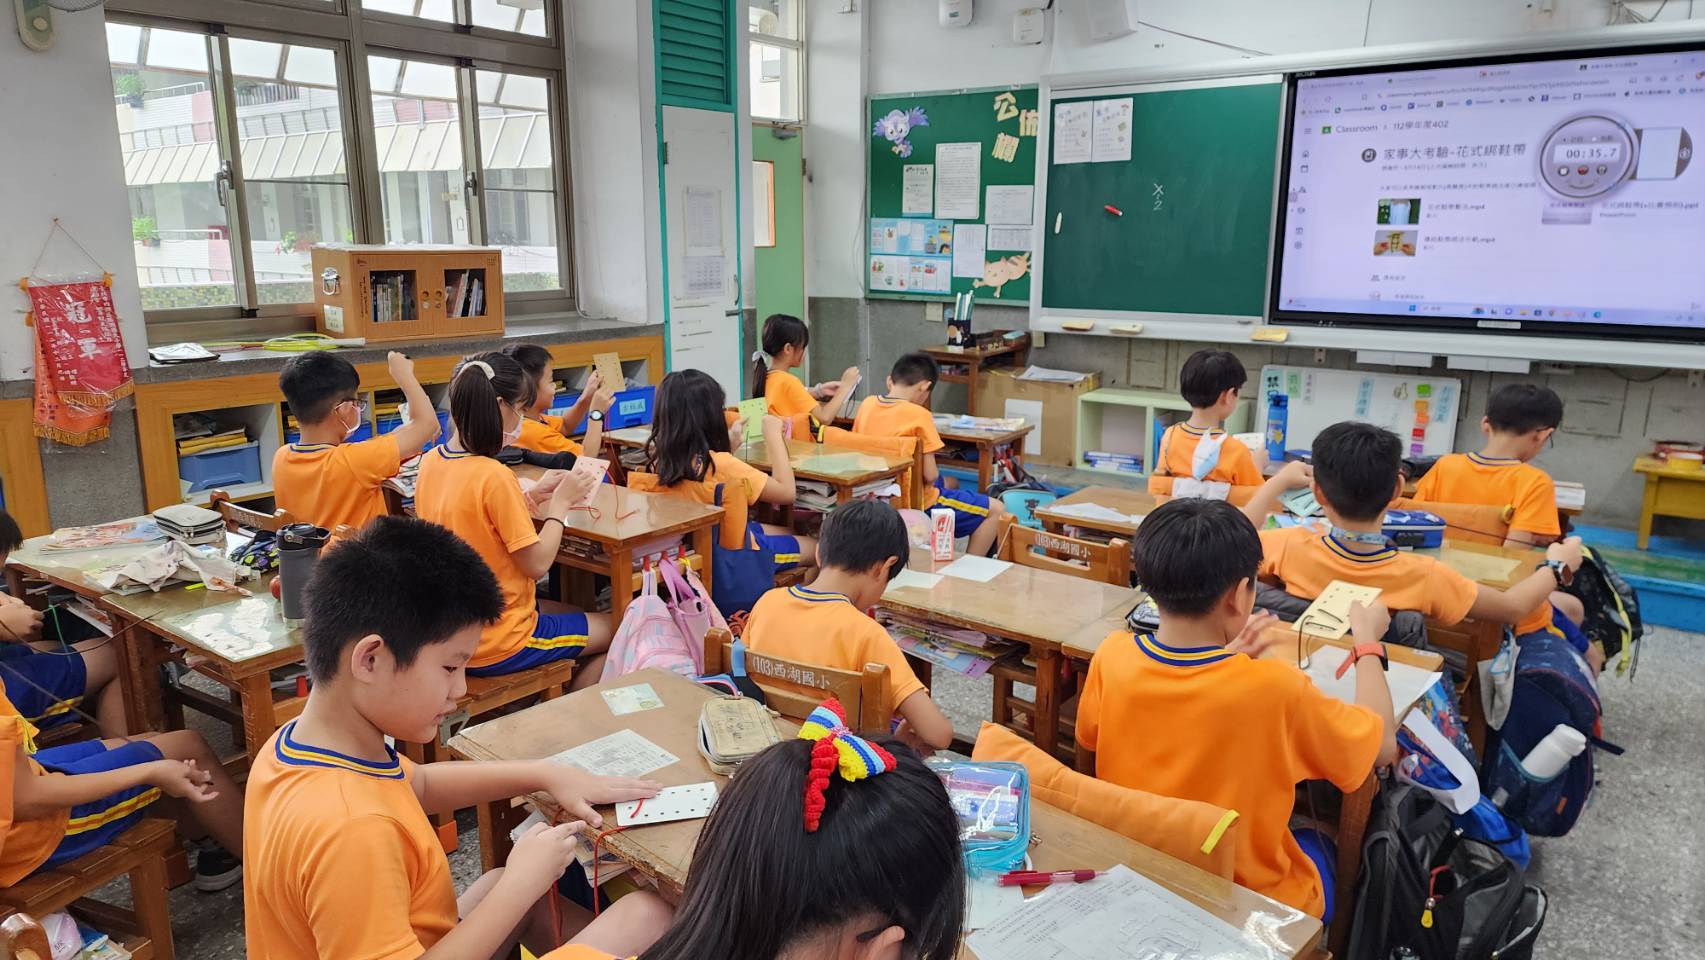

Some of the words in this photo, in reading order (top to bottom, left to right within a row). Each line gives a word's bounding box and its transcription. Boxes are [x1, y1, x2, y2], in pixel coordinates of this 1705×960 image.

[1336, 123, 1378, 134] Classroom
[1393, 120, 1449, 131] 112學年度402
[1383, 143, 1526, 160] 家事大考驗-花式綁鞋帶
[1566, 148, 1617, 159] 00:35.7
[752, 655, 831, 689] (103)西湖國小
